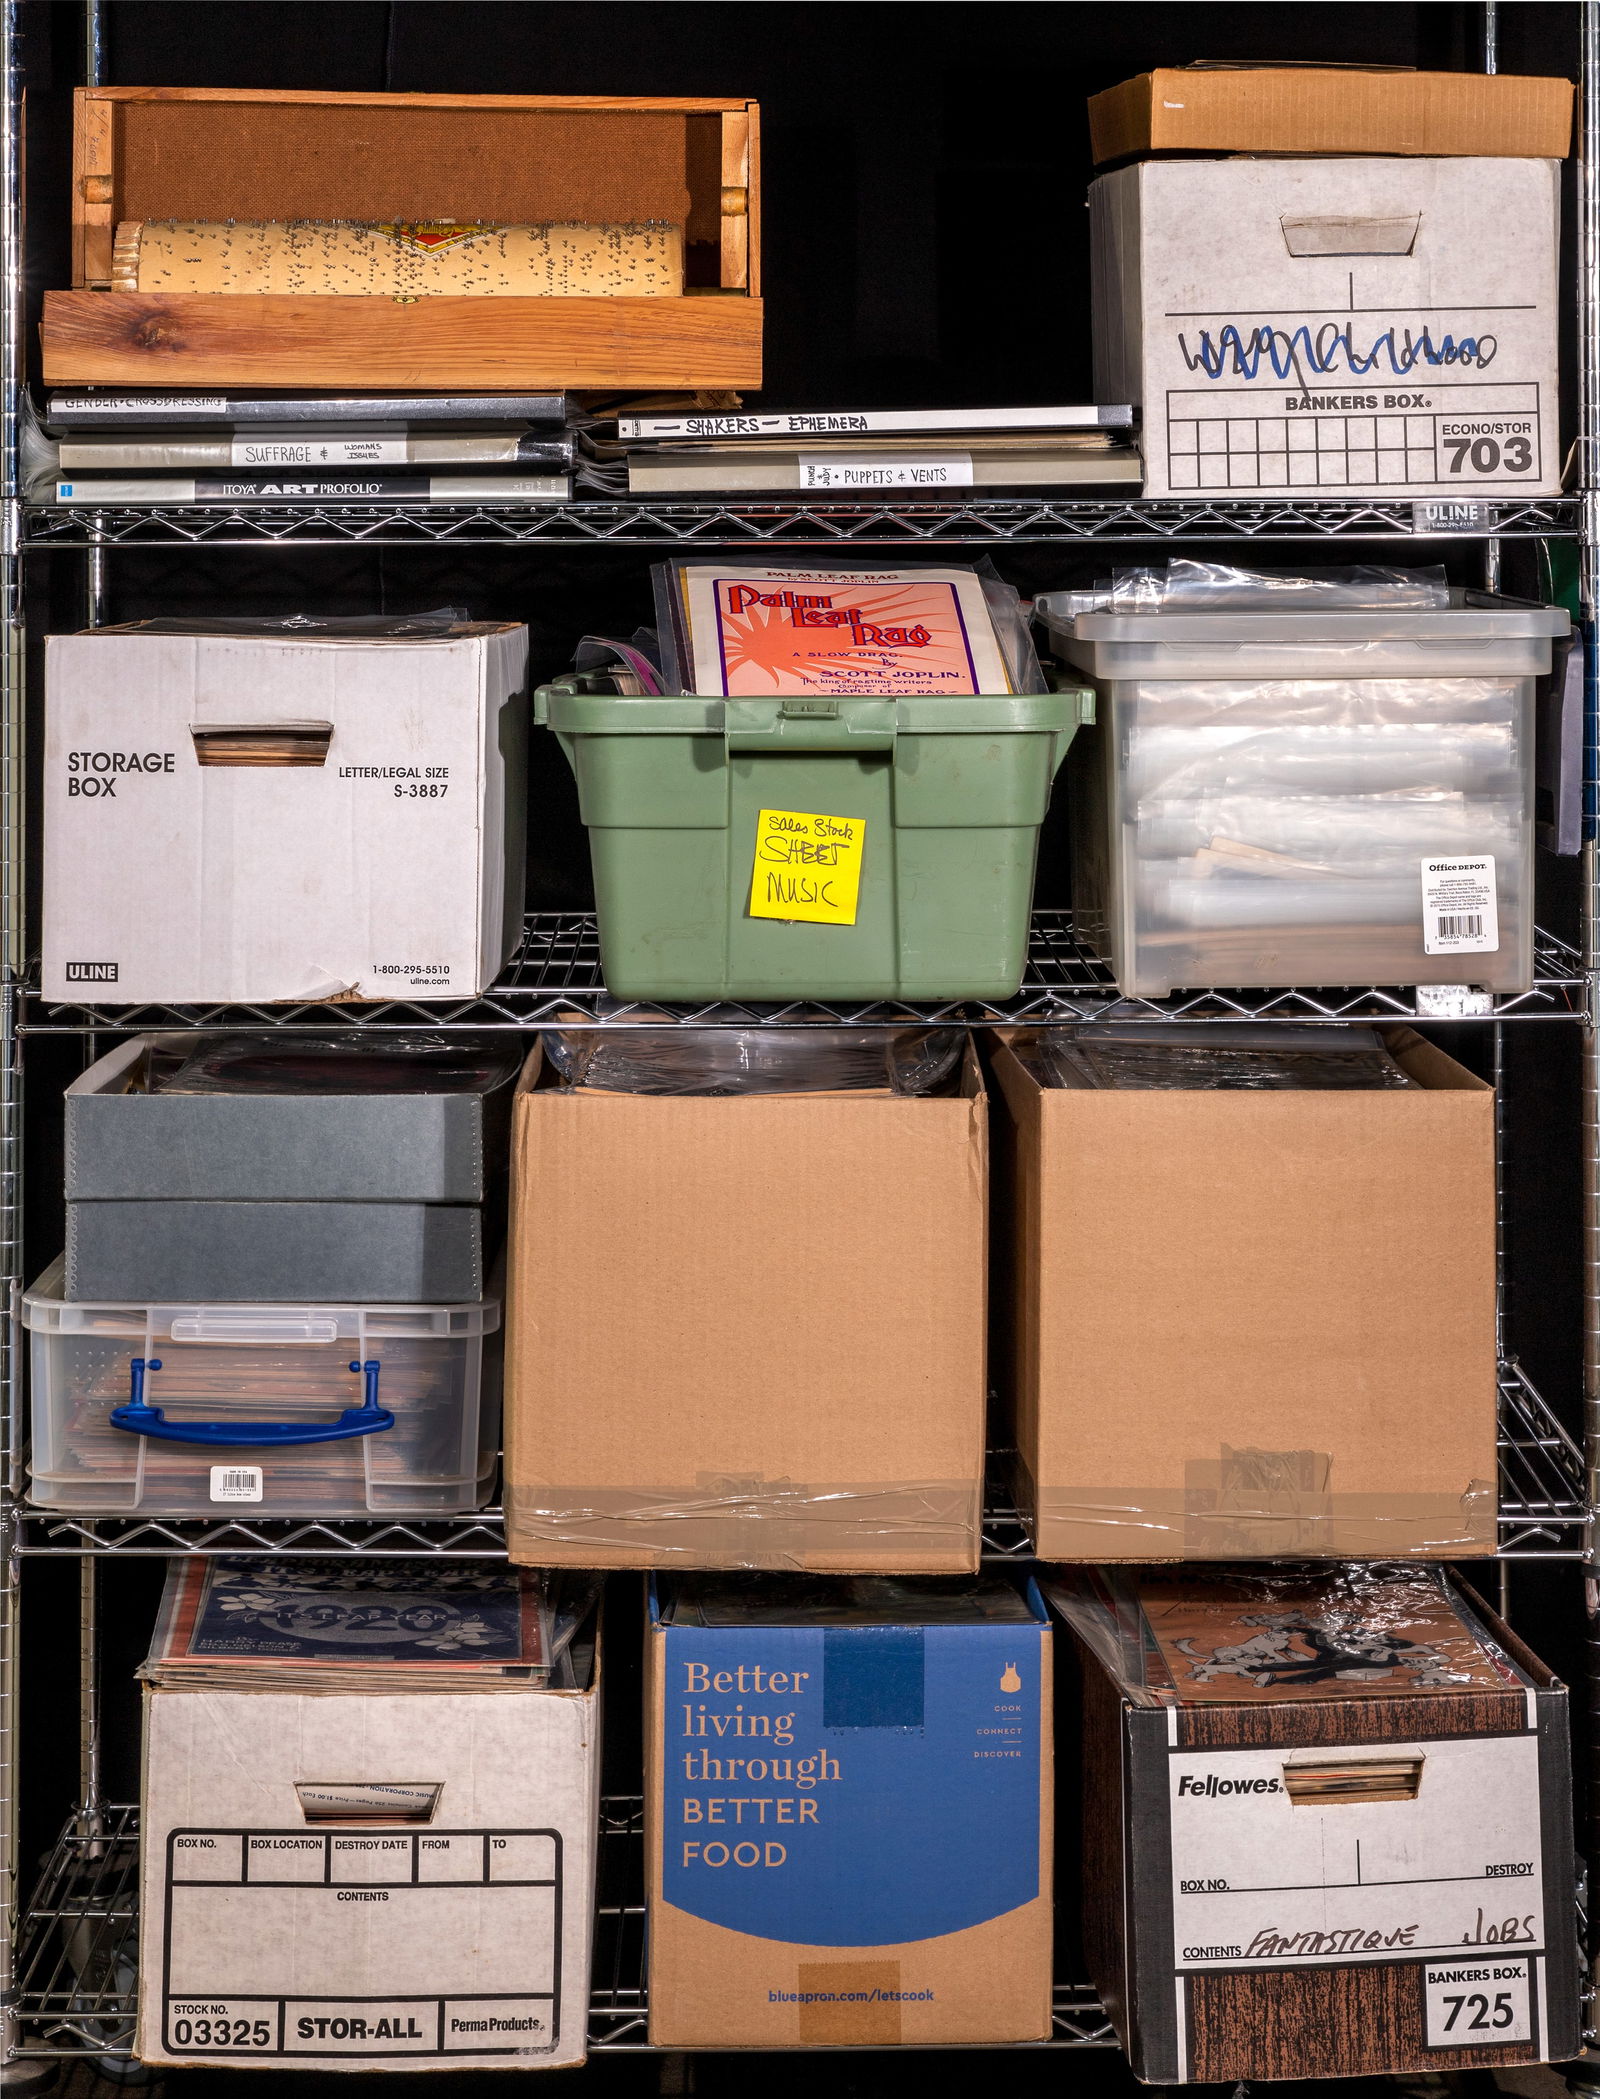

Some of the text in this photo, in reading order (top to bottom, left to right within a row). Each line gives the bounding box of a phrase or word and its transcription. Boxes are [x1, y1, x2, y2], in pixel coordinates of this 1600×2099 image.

[1285, 395, 1378, 411] BANKERS
[788, 416, 868, 431] EPHEMERA
[1442, 422, 1532, 435] ECONO/STOR
[245, 446, 311, 463] SUFFRAGE
[1443, 437, 1533, 474] 703
[844, 470, 893, 484] PUPPETS
[910, 467, 947, 482] VENTS
[260, 484, 318, 494] ART
[1426, 505, 1478, 520] ULINE
[728, 584, 833, 614] Palm
[791, 607, 864, 628] Leaf
[851, 624, 933, 649] Rag
[67, 752, 175, 773] STORAGE
[339, 766, 449, 780] LETTER/LEGAL SIZE
[68, 777, 116, 797] BOX
[394, 784, 448, 798] S-3887
[759, 835, 850, 866] SHEET
[1429, 863, 1457, 872] Office
[766, 872, 839, 907] MUSIC
[68, 965, 117, 980] ULINE
[373, 965, 450, 975] 1-800-295-5510
[410, 977, 450, 985] uline.com
[682, 1662, 809, 1694] Better
[682, 1704, 796, 1746] living
[682, 1749, 843, 1790] through
[369, 1786, 414, 1797] CORPORATION
[1178, 1775, 1279, 1798] Fellowes
[317, 1793, 333, 1801] $1.00
[683, 1798, 820, 1824] BETTER
[177, 1839, 217, 1849] BOX NO.
[251, 1840, 322, 1850] BOX LOCATION
[335, 1840, 408, 1850] DESTROY DATE
[422, 1840, 450, 1849] FROM
[492, 1839, 507, 1849] TO
[682, 1842, 787, 1868] FOOD
[1485, 1863, 1533, 1876] DESTROY
[1181, 1880, 1230, 1892] BOX NO.
[337, 1891, 389, 1902] CONTENTS
[1245, 1925, 1419, 1957] FANTASTIQUE
[1183, 1946, 1242, 1958] CONTENTS
[1428, 1970, 1489, 1984] BANKERS
[768, 1988, 934, 2003] blueapron.com/letscook
[174, 2005, 228, 2015] STOCK NO.
[1443, 1992, 1514, 2032] 725
[174, 2020, 270, 2046] 03325
[297, 2018, 422, 2040] STOR-ALL
[451, 2018, 488, 2033] Perma
